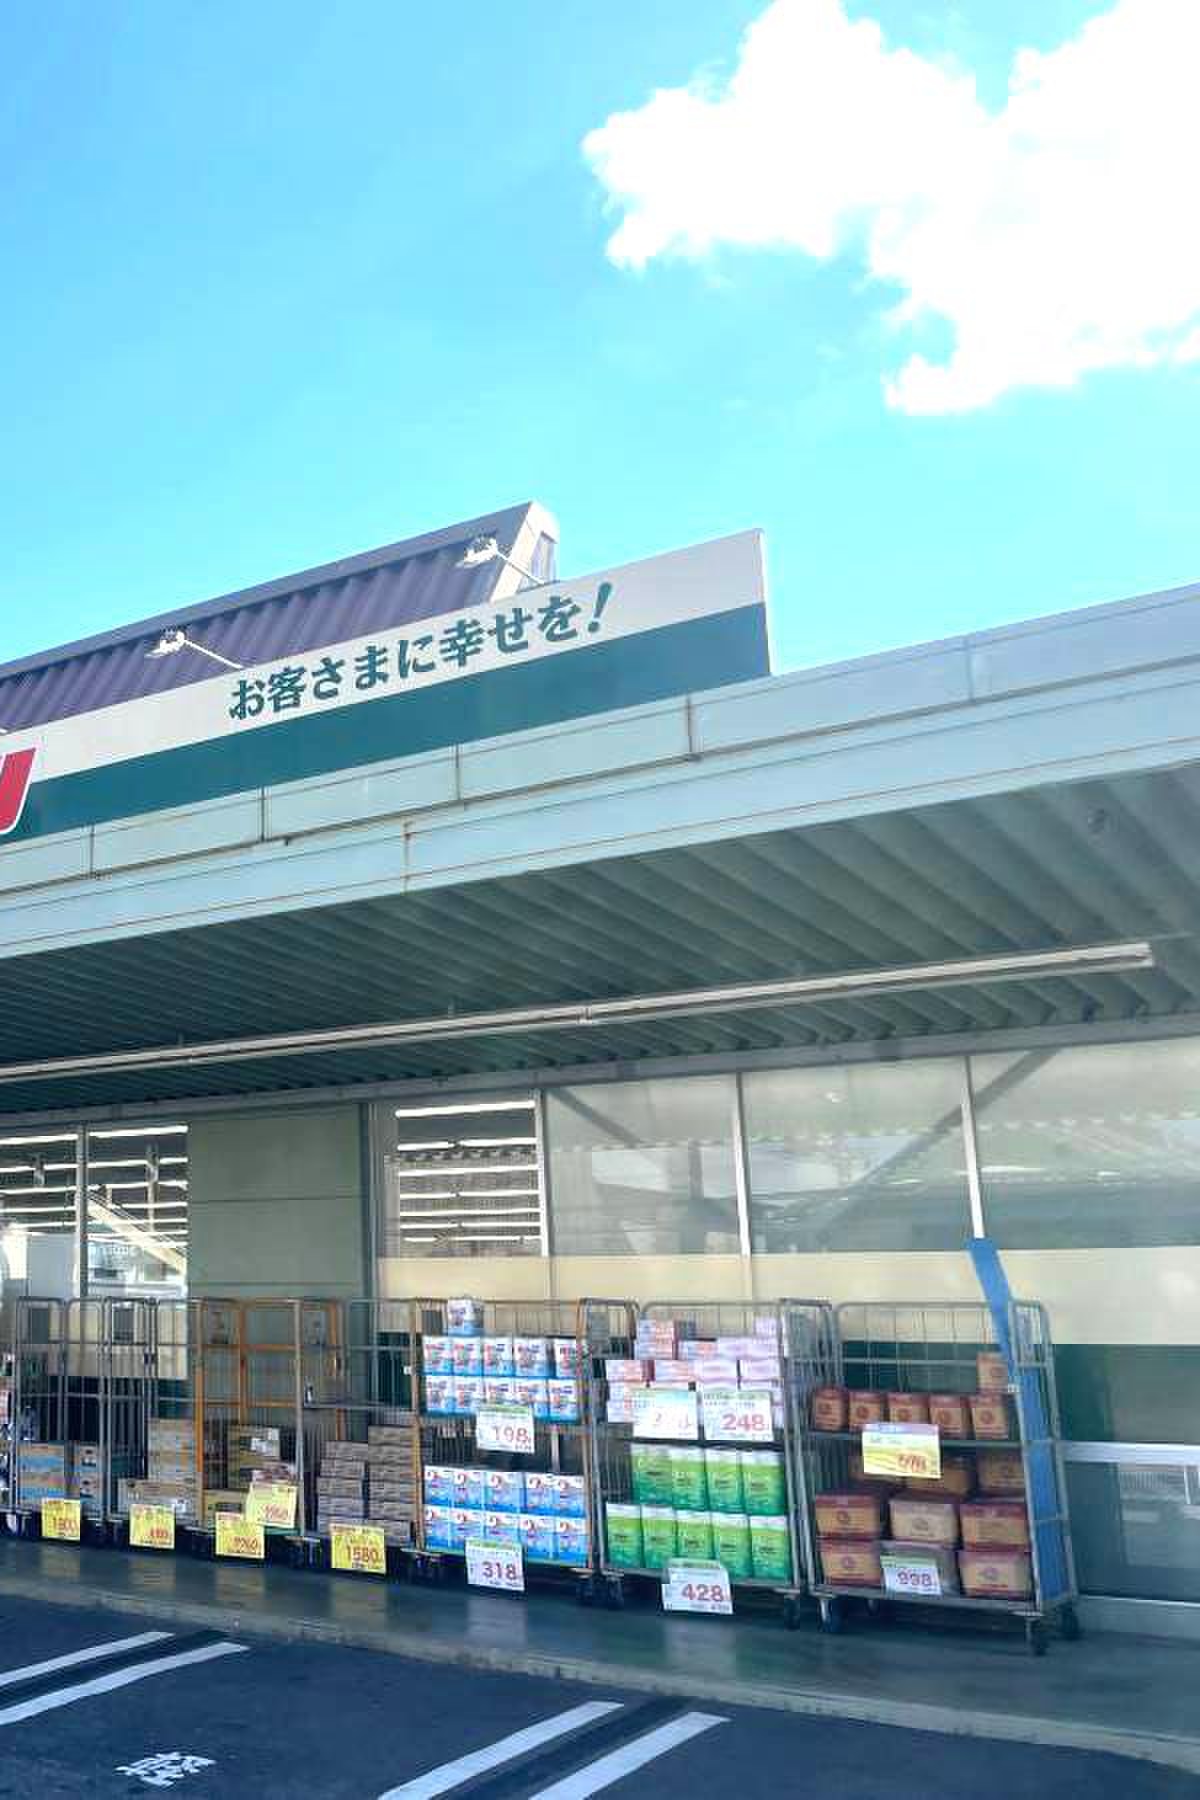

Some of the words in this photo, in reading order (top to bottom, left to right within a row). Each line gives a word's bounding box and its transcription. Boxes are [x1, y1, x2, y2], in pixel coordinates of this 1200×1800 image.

[228, 581, 613, 721] お客さまに幸せを!
[722, 1412, 766, 1432] 248
[491, 1424, 529, 1444] 198
[481, 1560, 517, 1581] 318
[681, 1582, 725, 1603] 428
